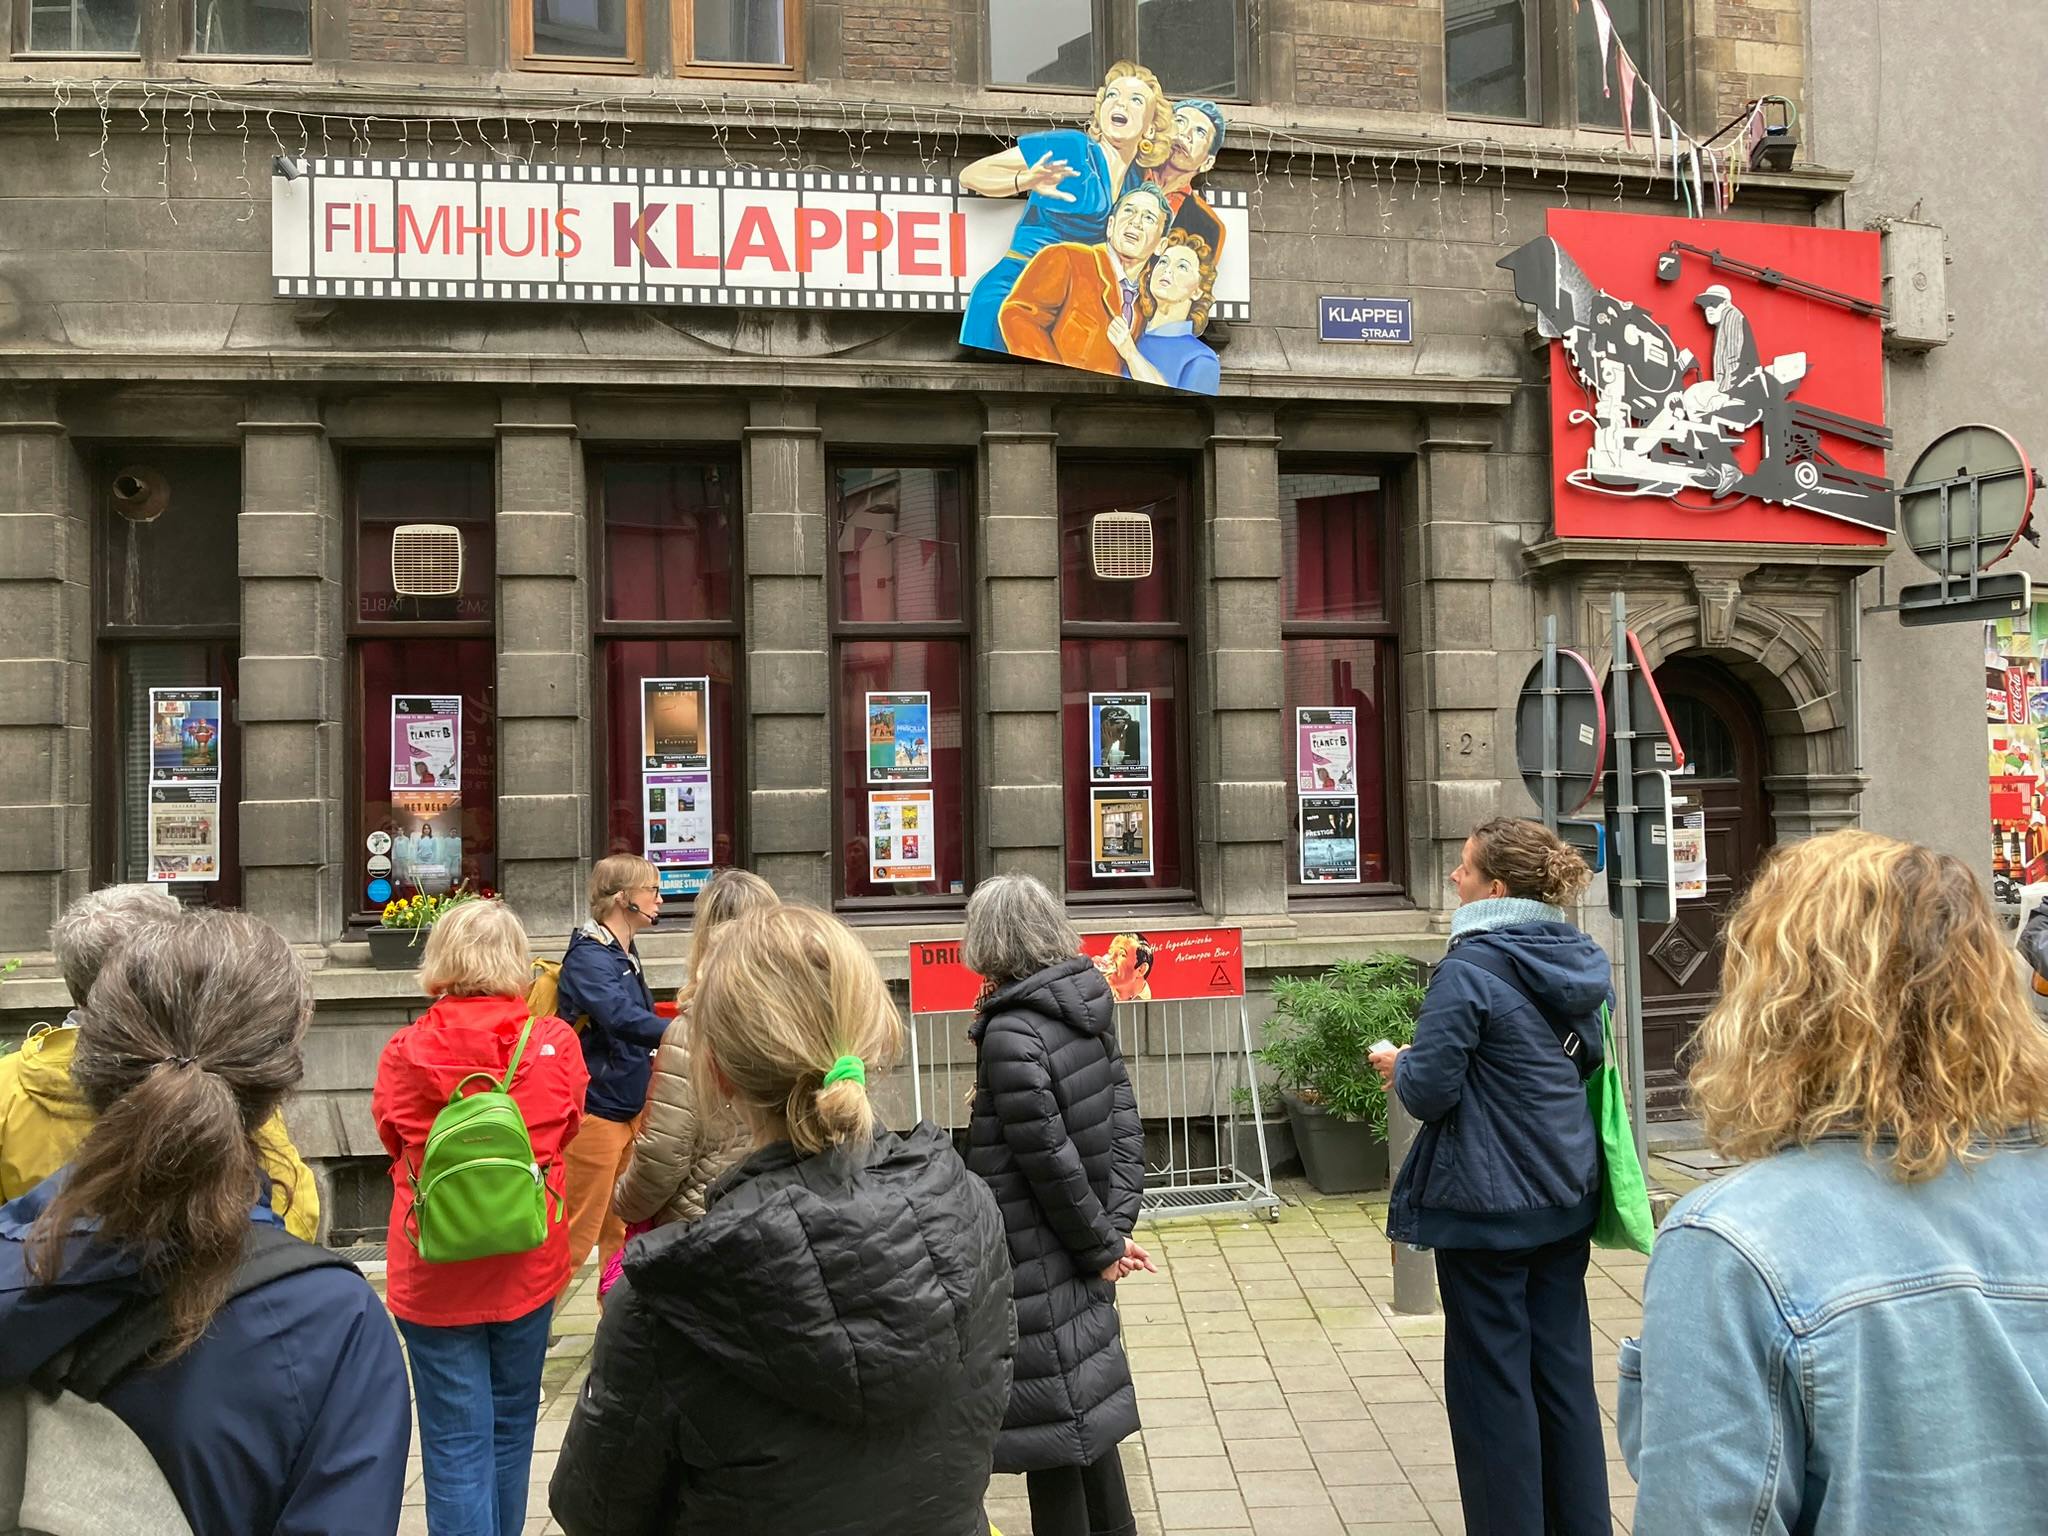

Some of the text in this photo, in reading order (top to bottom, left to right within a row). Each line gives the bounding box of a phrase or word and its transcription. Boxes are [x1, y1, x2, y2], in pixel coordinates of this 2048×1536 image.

[324, 200, 967, 278] FILMHUIS KLAPPEI
[1328, 306, 1402, 324] KLAPPEI
[1361, 328, 1400, 338] STRAAT
[442, 726, 451, 739] B
[1340, 735, 1347, 746] B
[1460, 733, 1473, 755] 2
[660, 879, 684, 889] LIDAIRE
